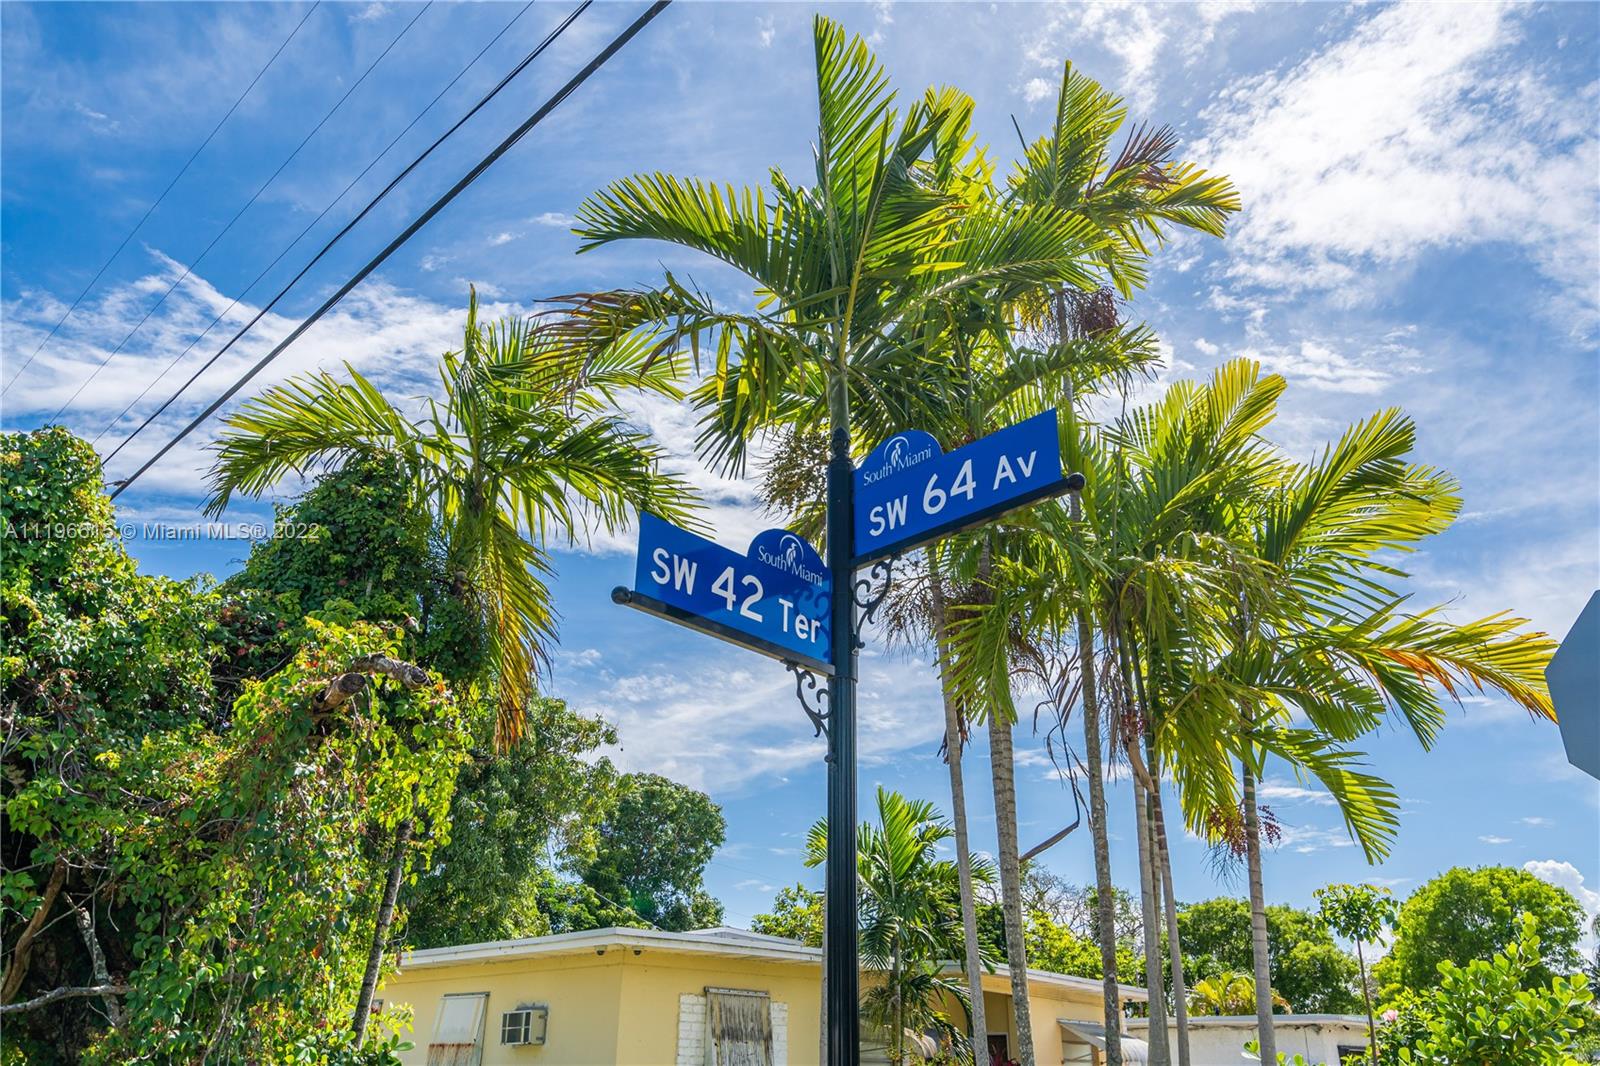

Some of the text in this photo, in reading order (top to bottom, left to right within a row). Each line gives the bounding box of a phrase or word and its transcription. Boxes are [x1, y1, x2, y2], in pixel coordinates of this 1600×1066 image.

[863, 443, 932, 487] South Miami
[869, 451, 1037, 537] SW 64 Av
[650, 547, 821, 643] SW 42 Ter
[758, 545, 823, 587] South Miami
